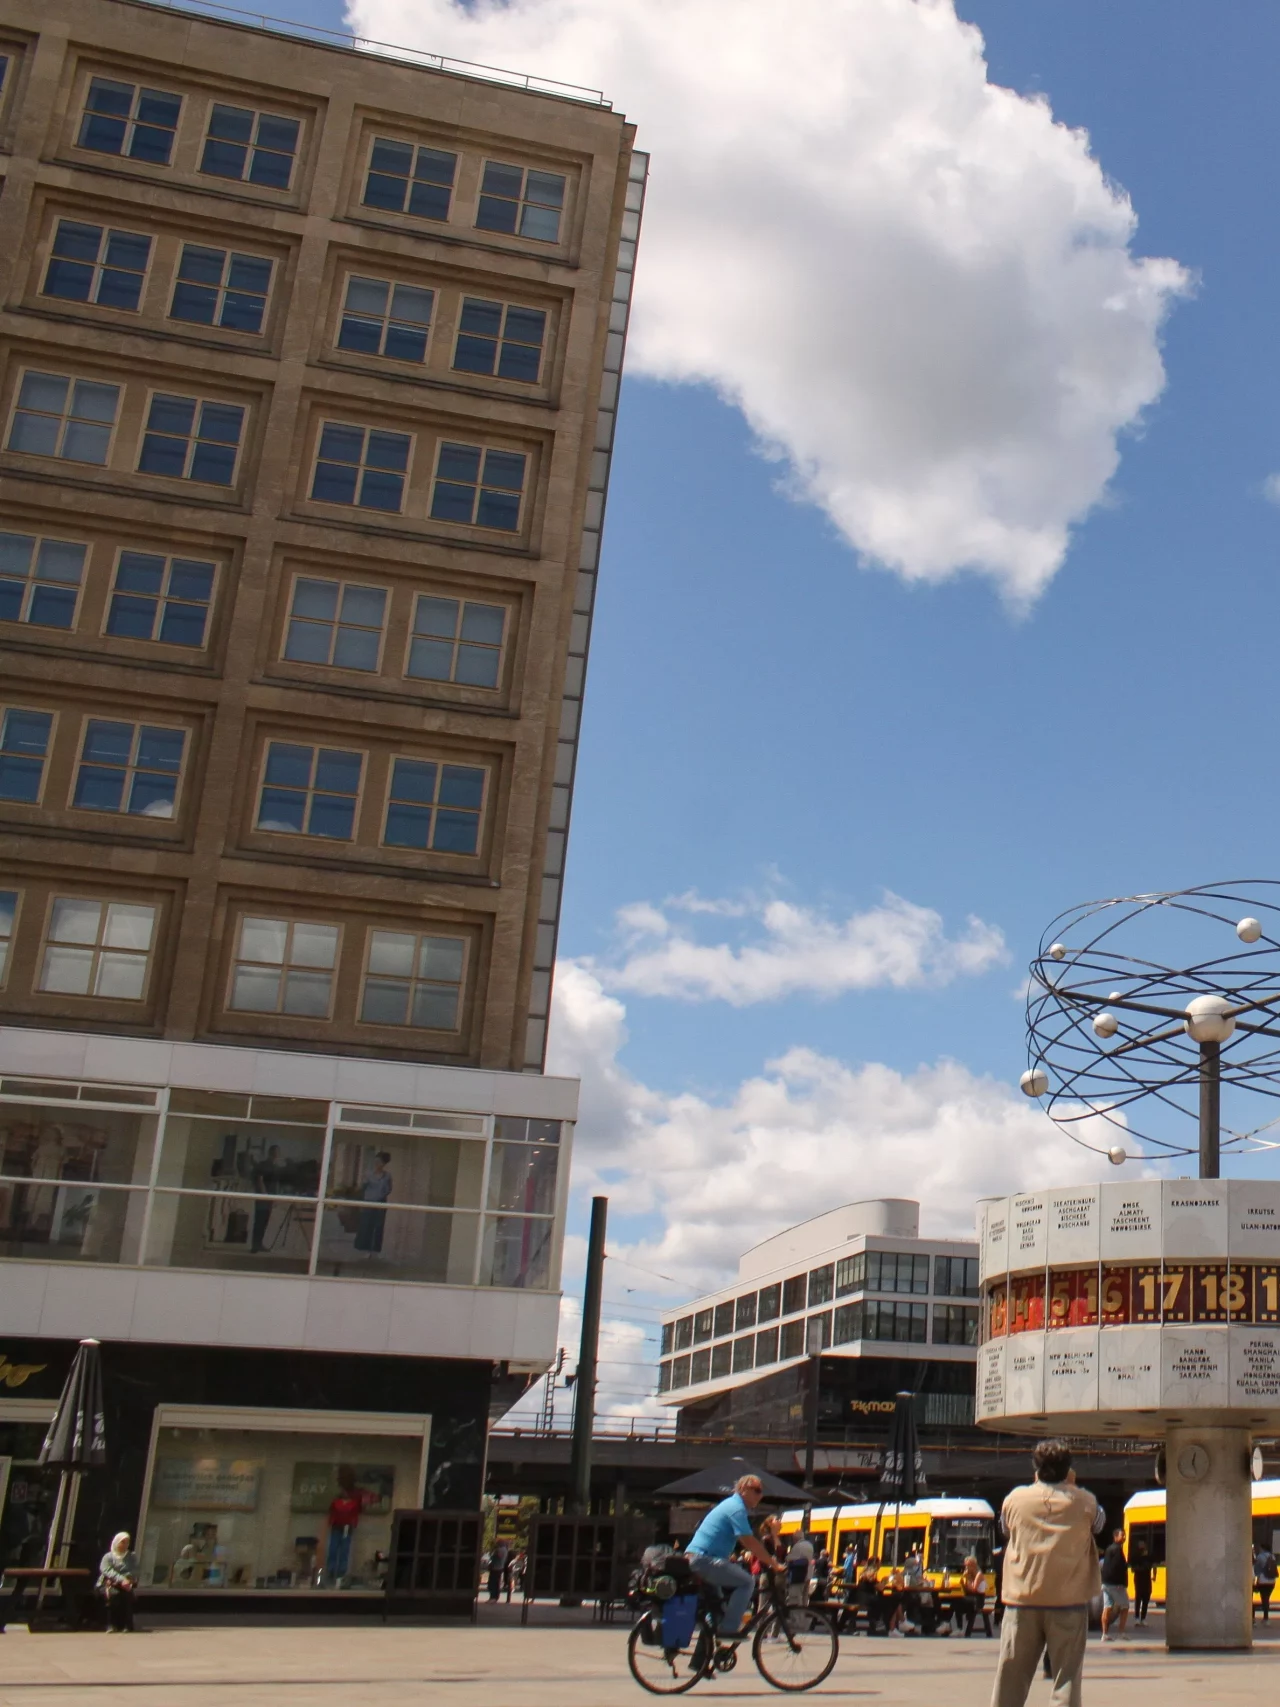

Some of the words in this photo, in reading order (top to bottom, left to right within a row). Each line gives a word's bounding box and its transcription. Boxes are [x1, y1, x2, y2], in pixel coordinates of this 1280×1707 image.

[1058, 1205, 1091, 1214] ASCHGABAT
[1247, 1208, 1275, 1216] IRKUTSK
[1061, 1213, 1087, 1222] BISCHKEK
[1113, 1217, 1150, 1225] TASCHKENT
[1057, 1220, 1090, 1230] DUSCHANBE
[1110, 1224, 1152, 1232] NOWOSIBIRSK
[1084, 1276, 1123, 1313] 16
[1138, 1274, 1185, 1311] 17
[1200, 1274, 1246, 1311] 18
[1184, 1348, 1206, 1356] HANOI
[1172, 1364, 1197, 1372] PHNOM
